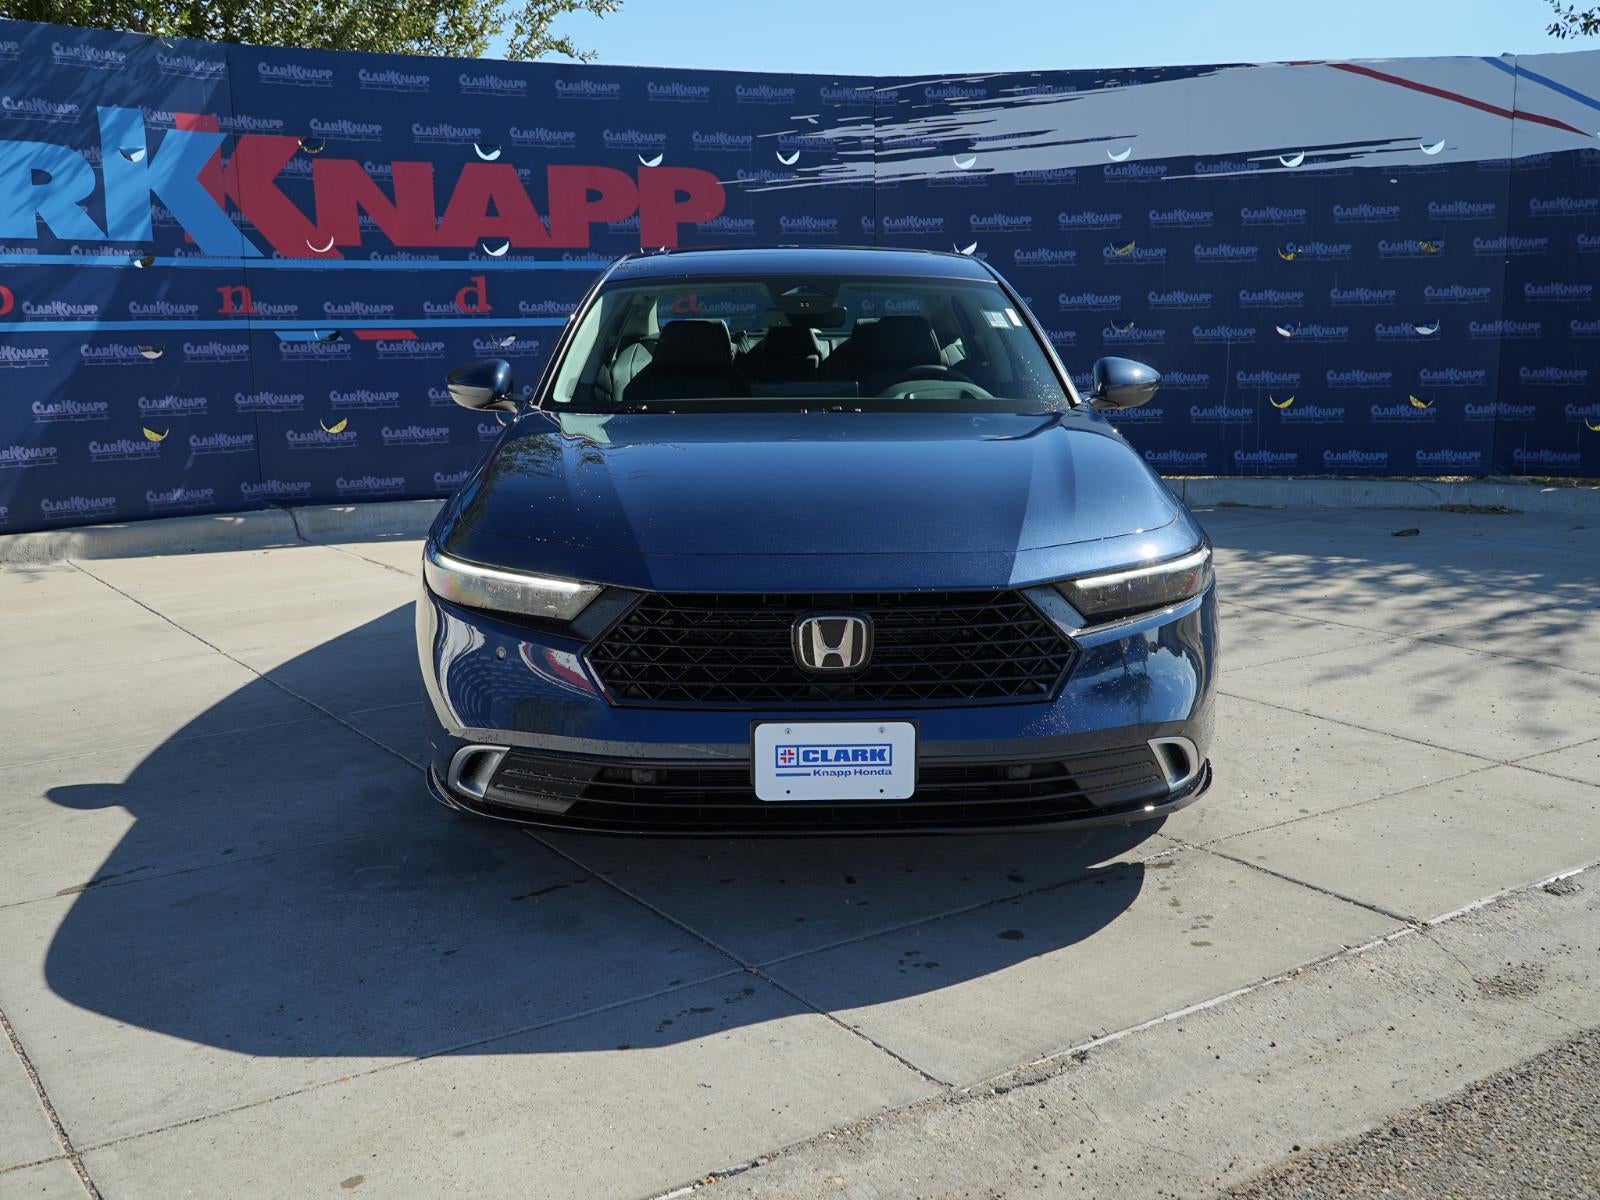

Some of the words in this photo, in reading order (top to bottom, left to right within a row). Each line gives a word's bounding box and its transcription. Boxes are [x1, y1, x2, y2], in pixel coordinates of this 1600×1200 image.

[802, 749, 887, 762] CLARK
[813, 769, 851, 778] Knapp
[854, 769, 892, 777] Honda
